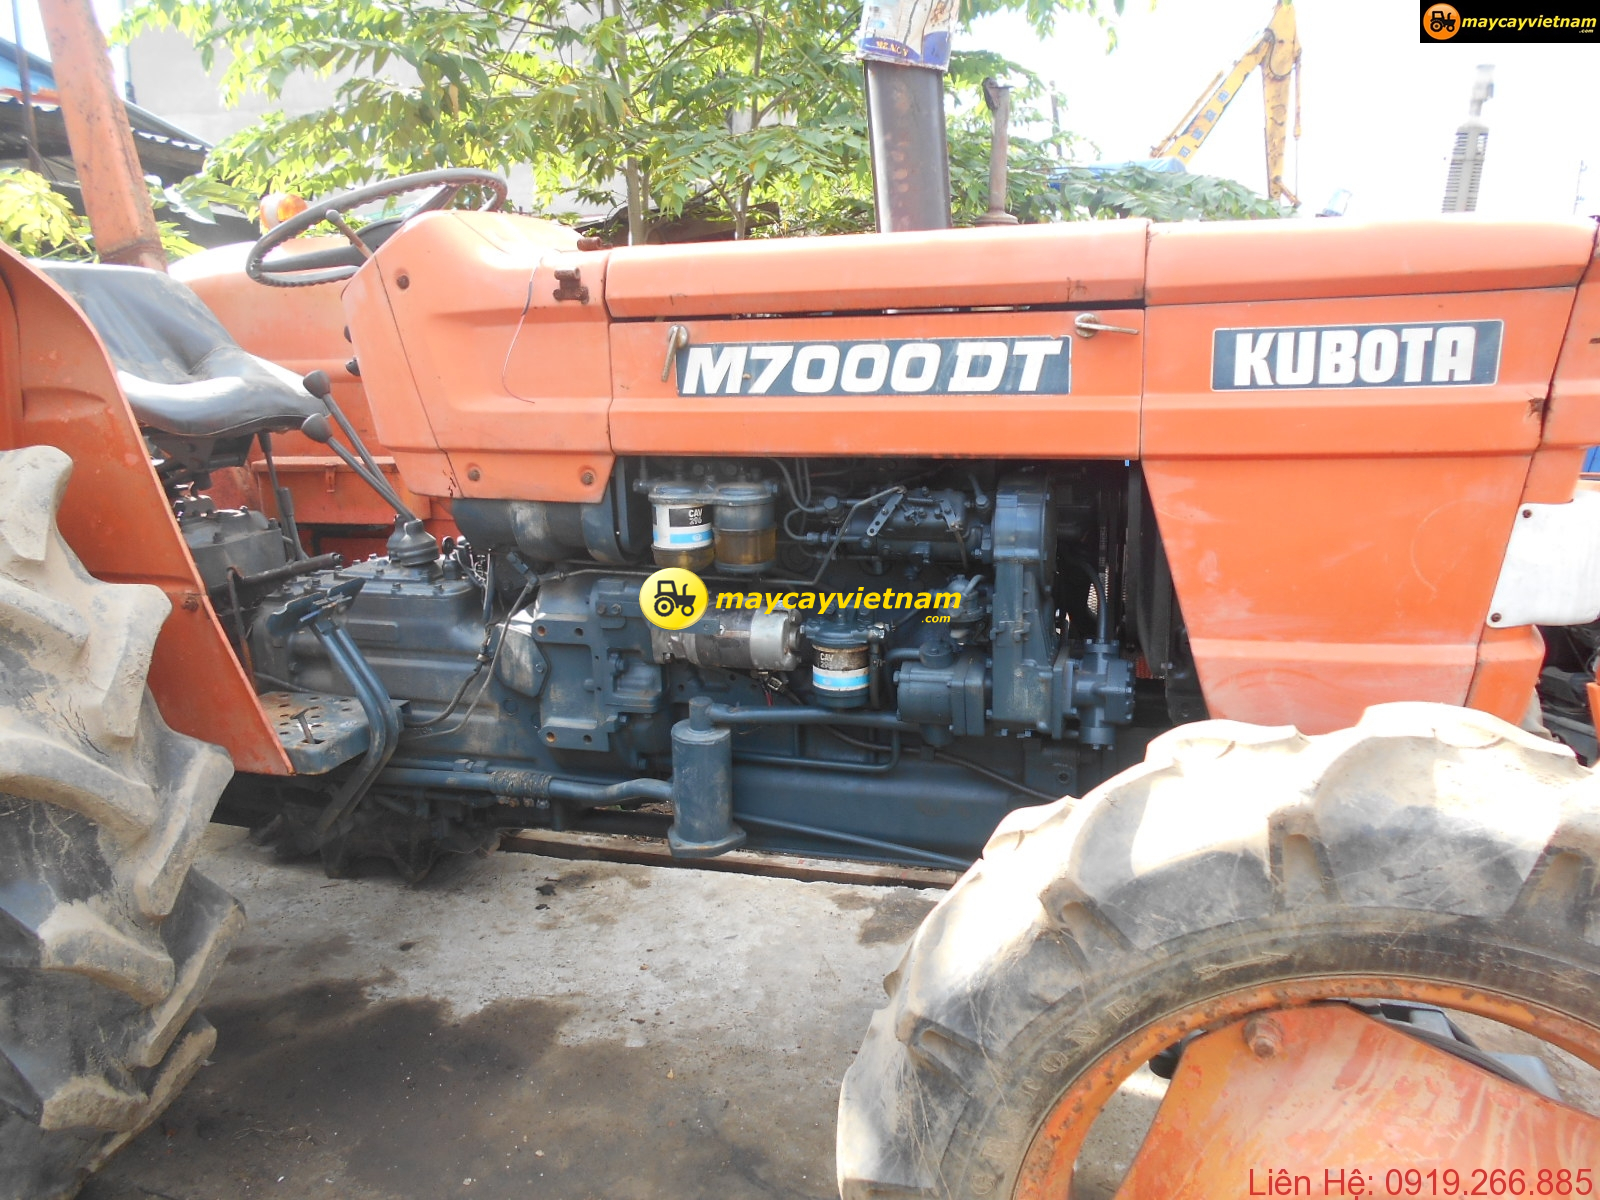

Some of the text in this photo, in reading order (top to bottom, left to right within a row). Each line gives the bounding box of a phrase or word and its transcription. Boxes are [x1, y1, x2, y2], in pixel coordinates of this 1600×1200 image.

[1233, 326, 1476, 387] KUBOTA
[688, 508, 703, 518] CAV
[819, 652, 834, 662] CAV
